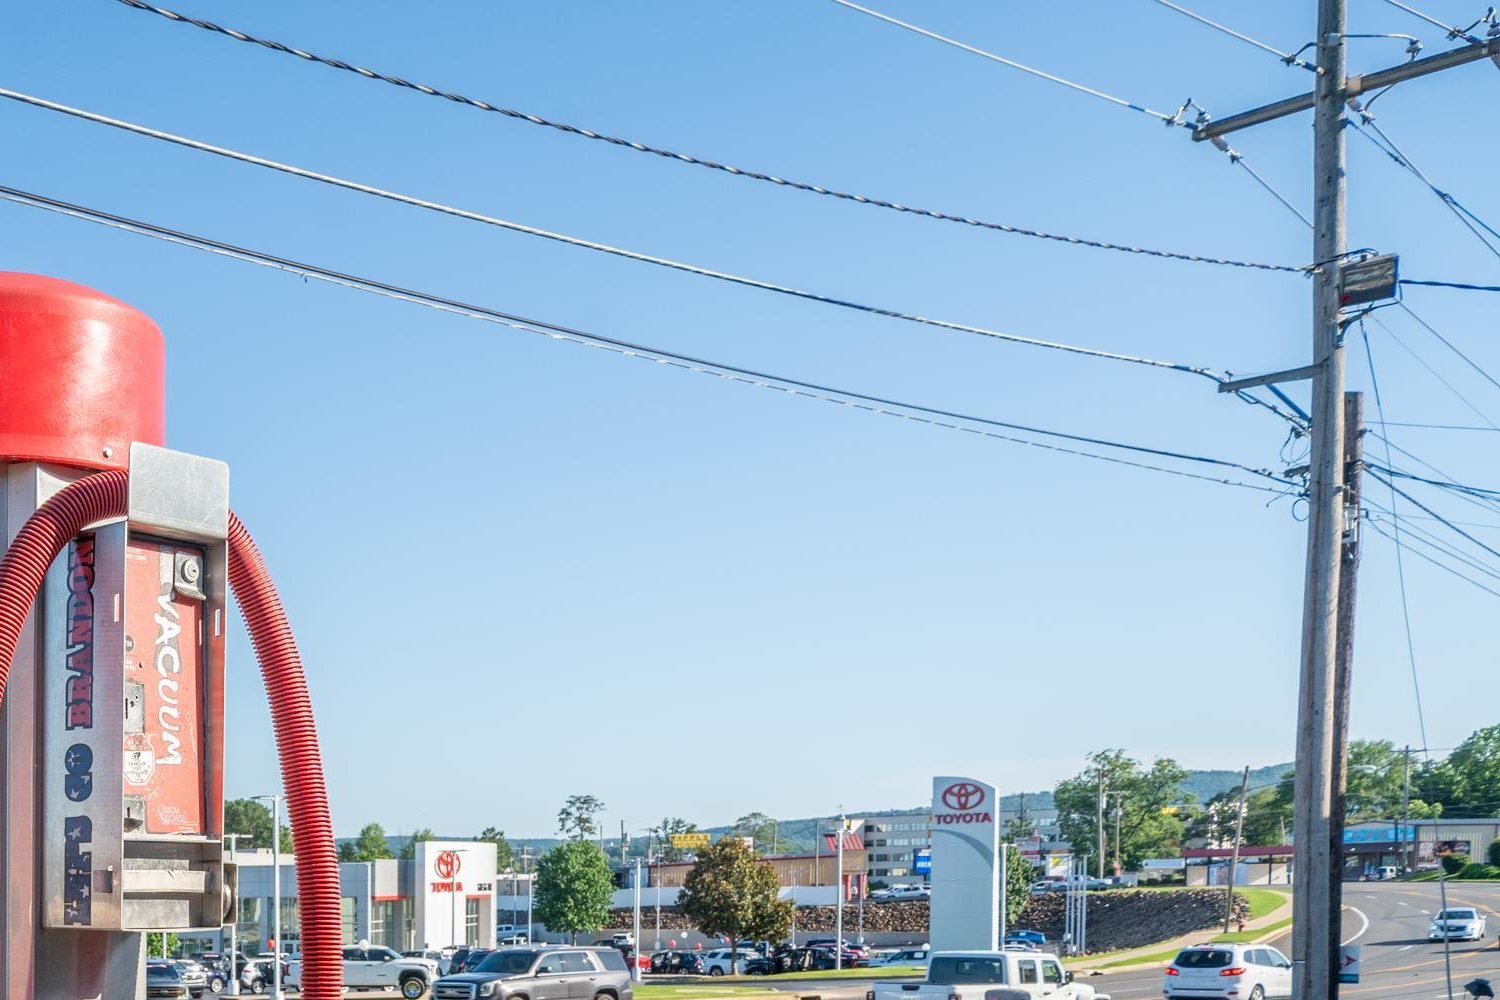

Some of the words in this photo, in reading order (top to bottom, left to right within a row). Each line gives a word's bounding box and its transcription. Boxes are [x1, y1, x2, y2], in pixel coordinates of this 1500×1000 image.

[65, 531, 97, 731] BRANDON
[153, 593, 182, 765] VACUUM
[64, 743, 94, 802] GO
[934, 812, 992, 825] TOYOTA
[431, 882, 464, 893] TOYOA
